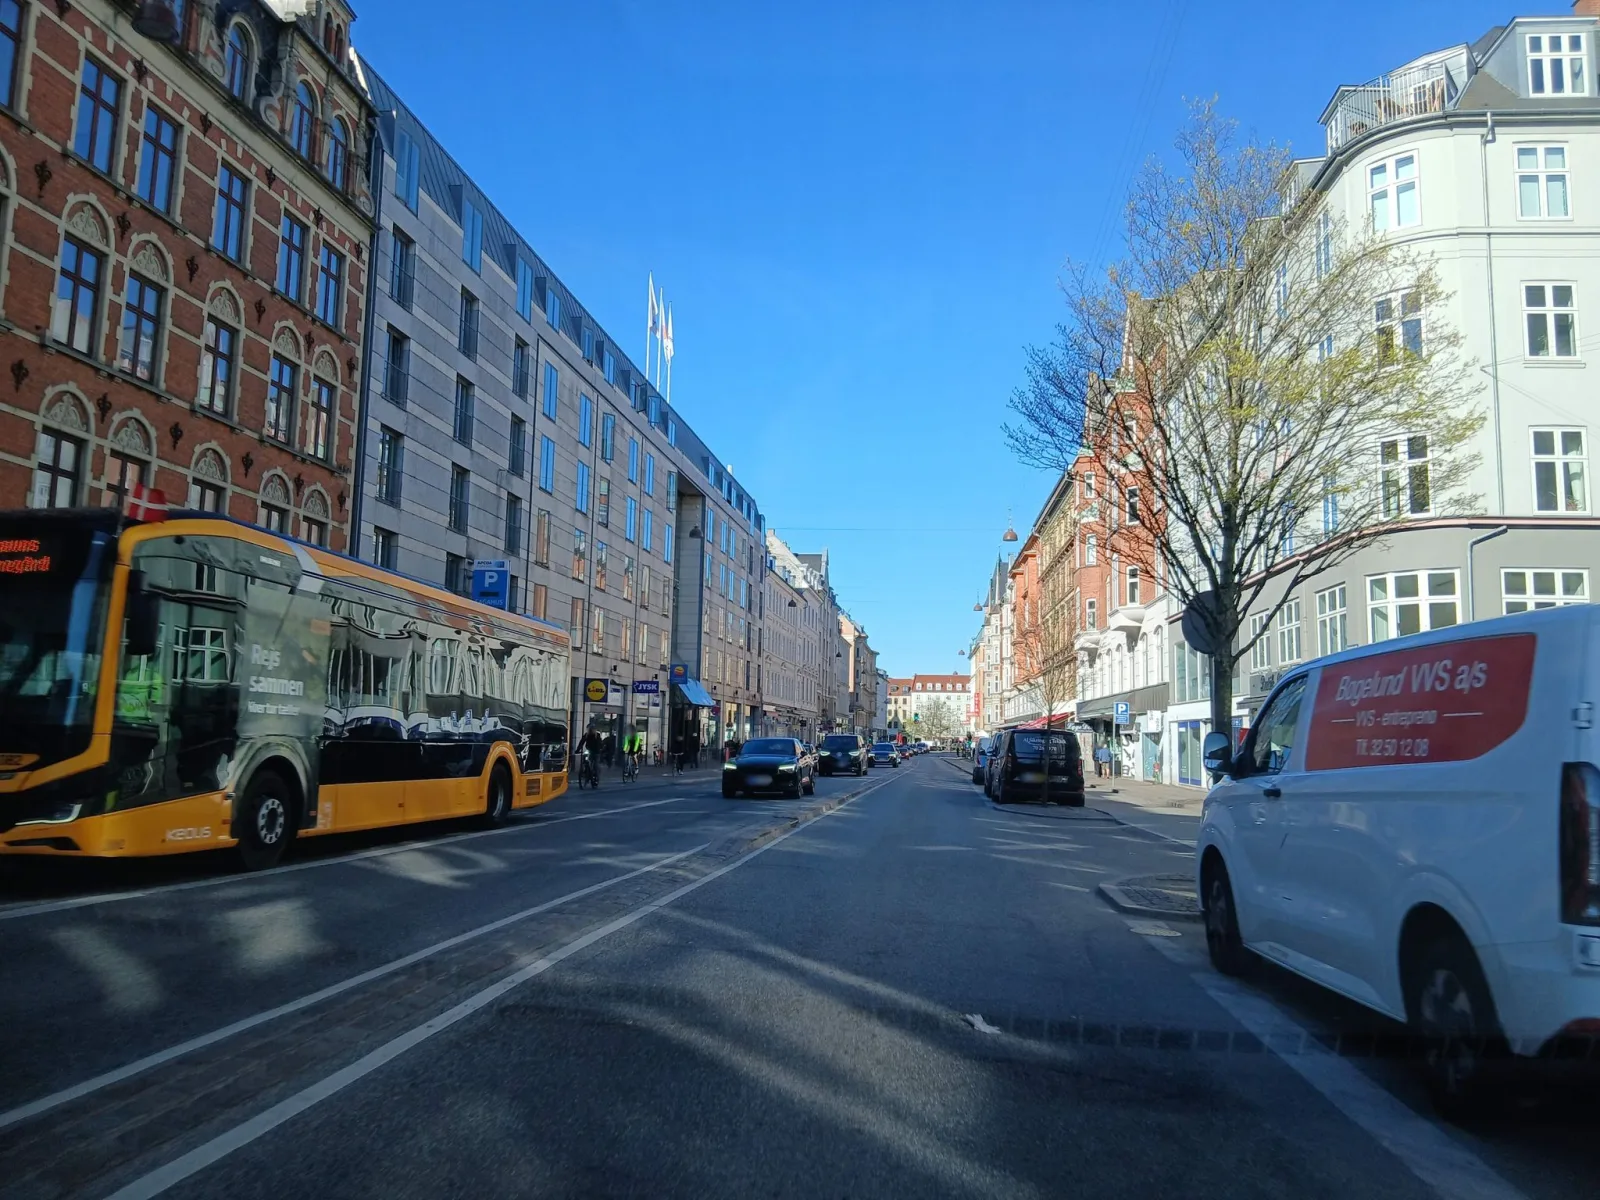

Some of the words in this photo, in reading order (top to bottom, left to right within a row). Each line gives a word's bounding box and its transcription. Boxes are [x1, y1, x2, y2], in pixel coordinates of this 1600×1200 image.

[484, 571, 499, 588] P
[1411, 659, 1452, 693] VVS
[1454, 661, 1488, 694] a/s
[249, 676, 304, 696] sammen
[1118, 704, 1126, 714] P
[1400, 739, 1413, 756] 12
